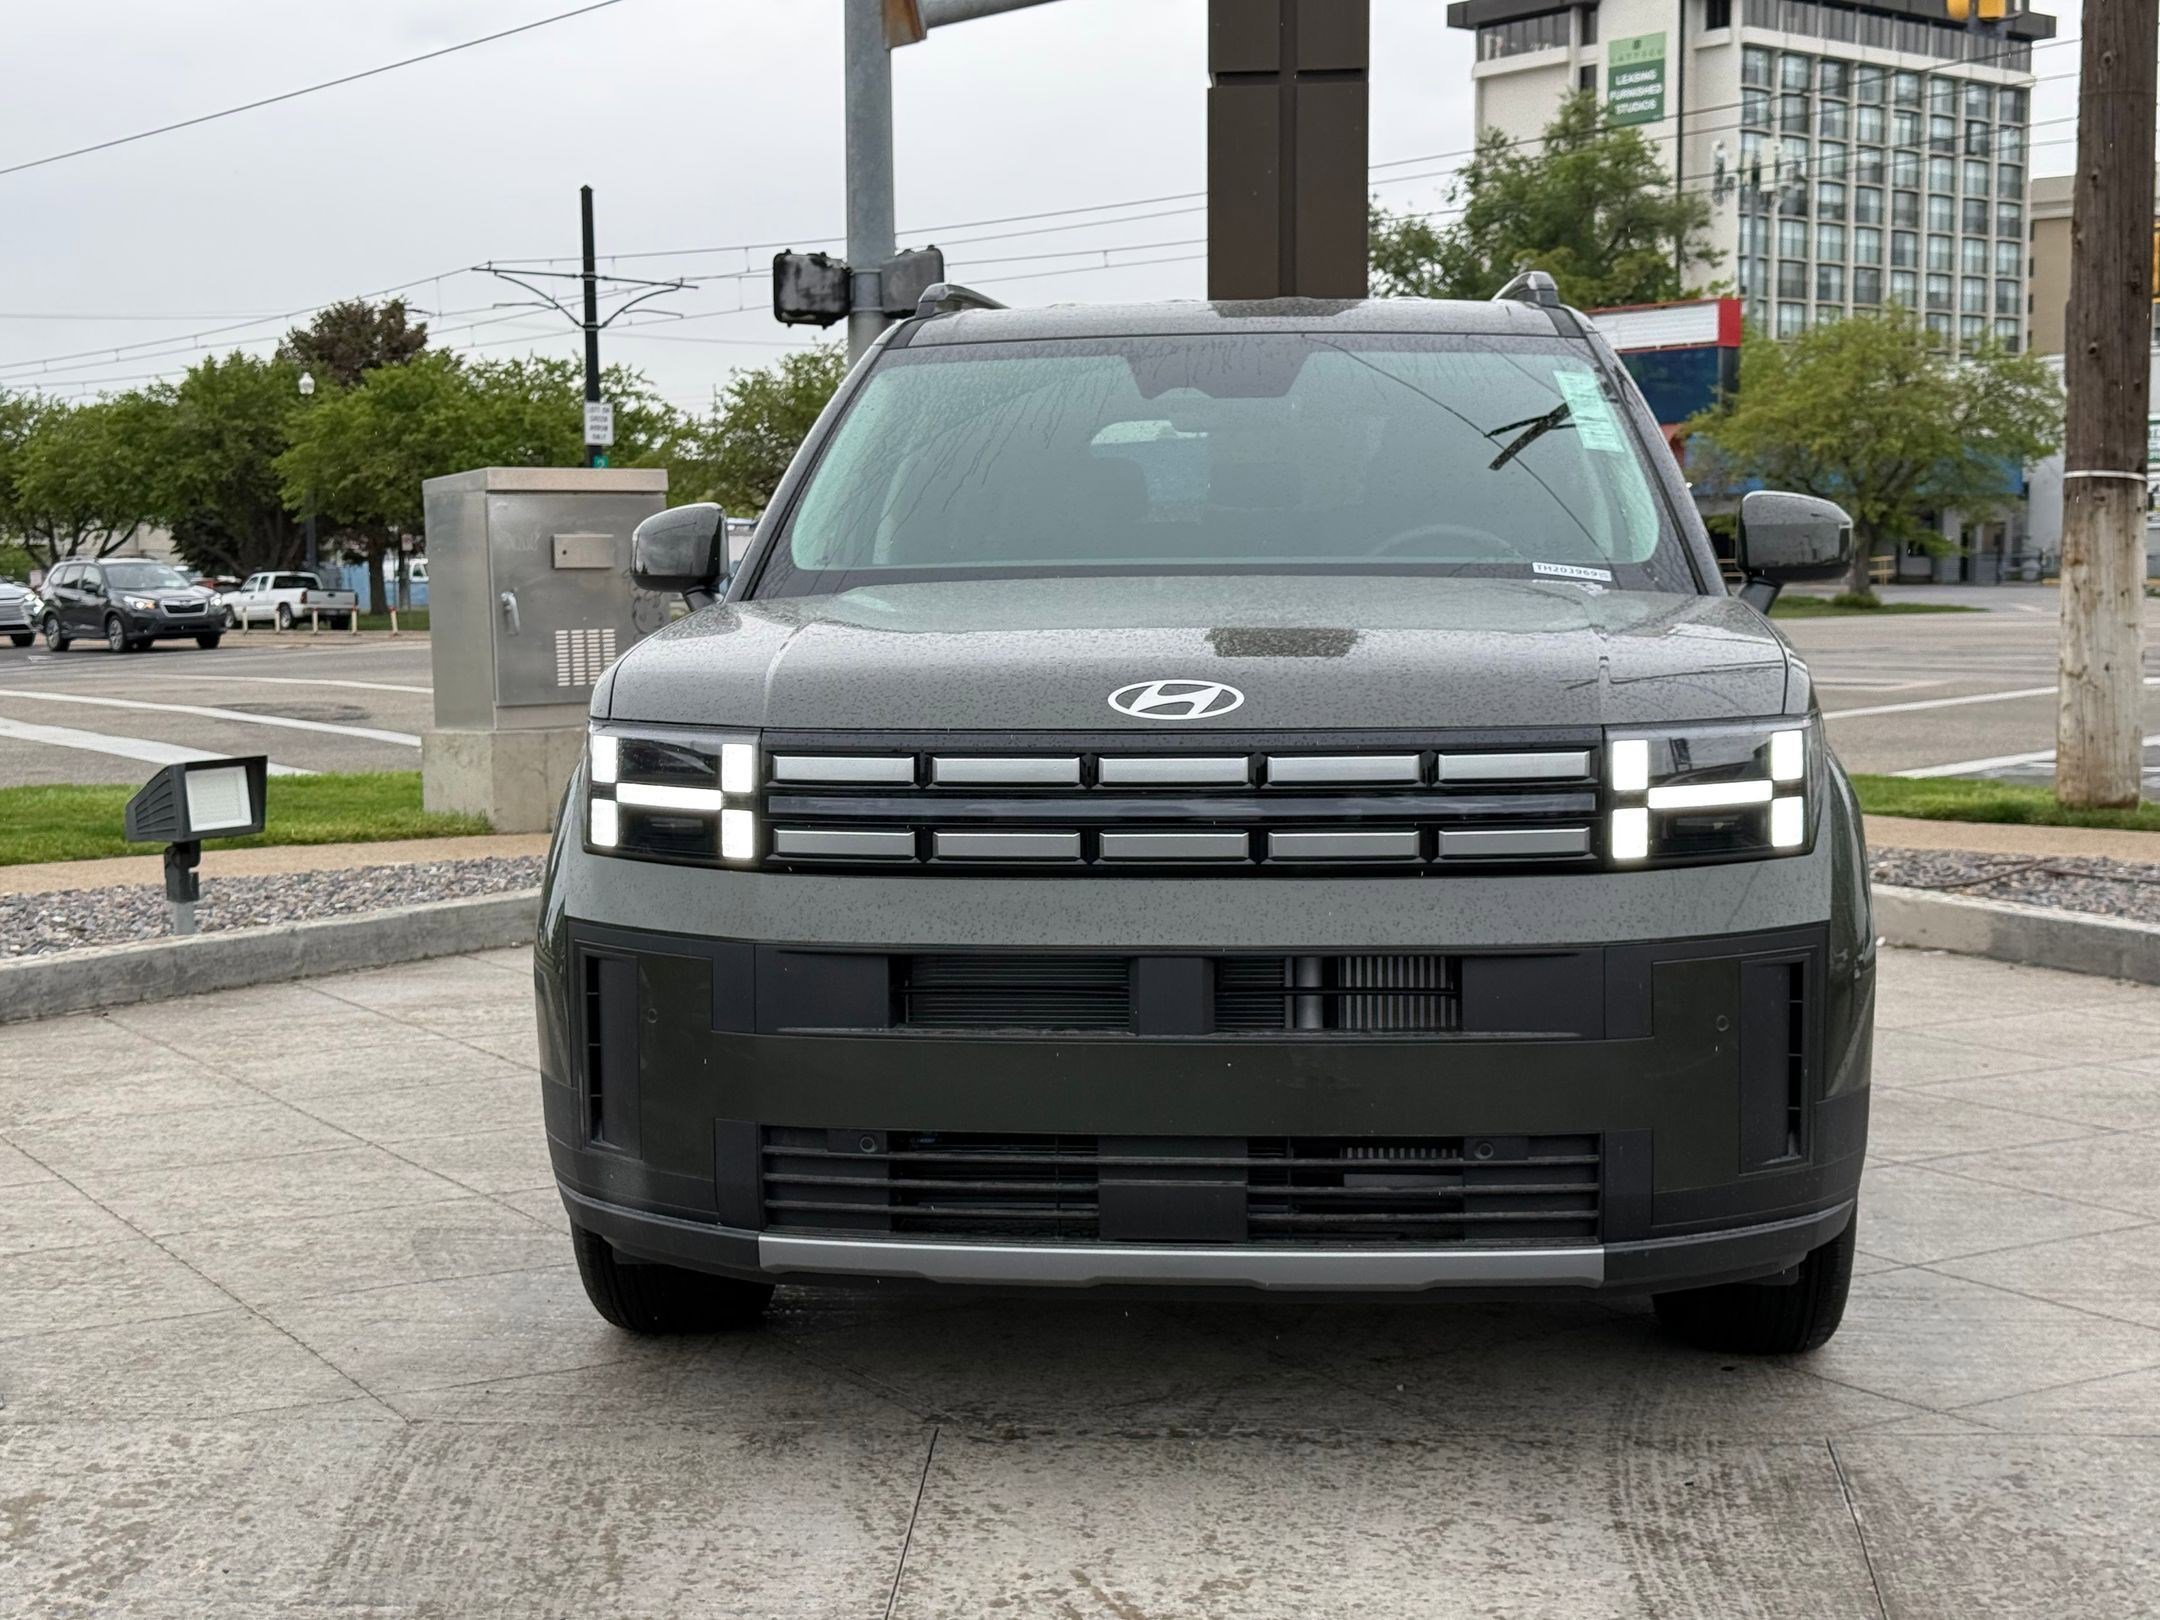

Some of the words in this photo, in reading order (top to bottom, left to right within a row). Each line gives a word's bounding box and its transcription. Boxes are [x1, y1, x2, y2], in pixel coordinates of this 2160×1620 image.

[1615, 69, 1657, 86] LEASING
[1608, 83, 1663, 101] FURNISHED
[1615, 98, 1657, 115] STUDIOS
